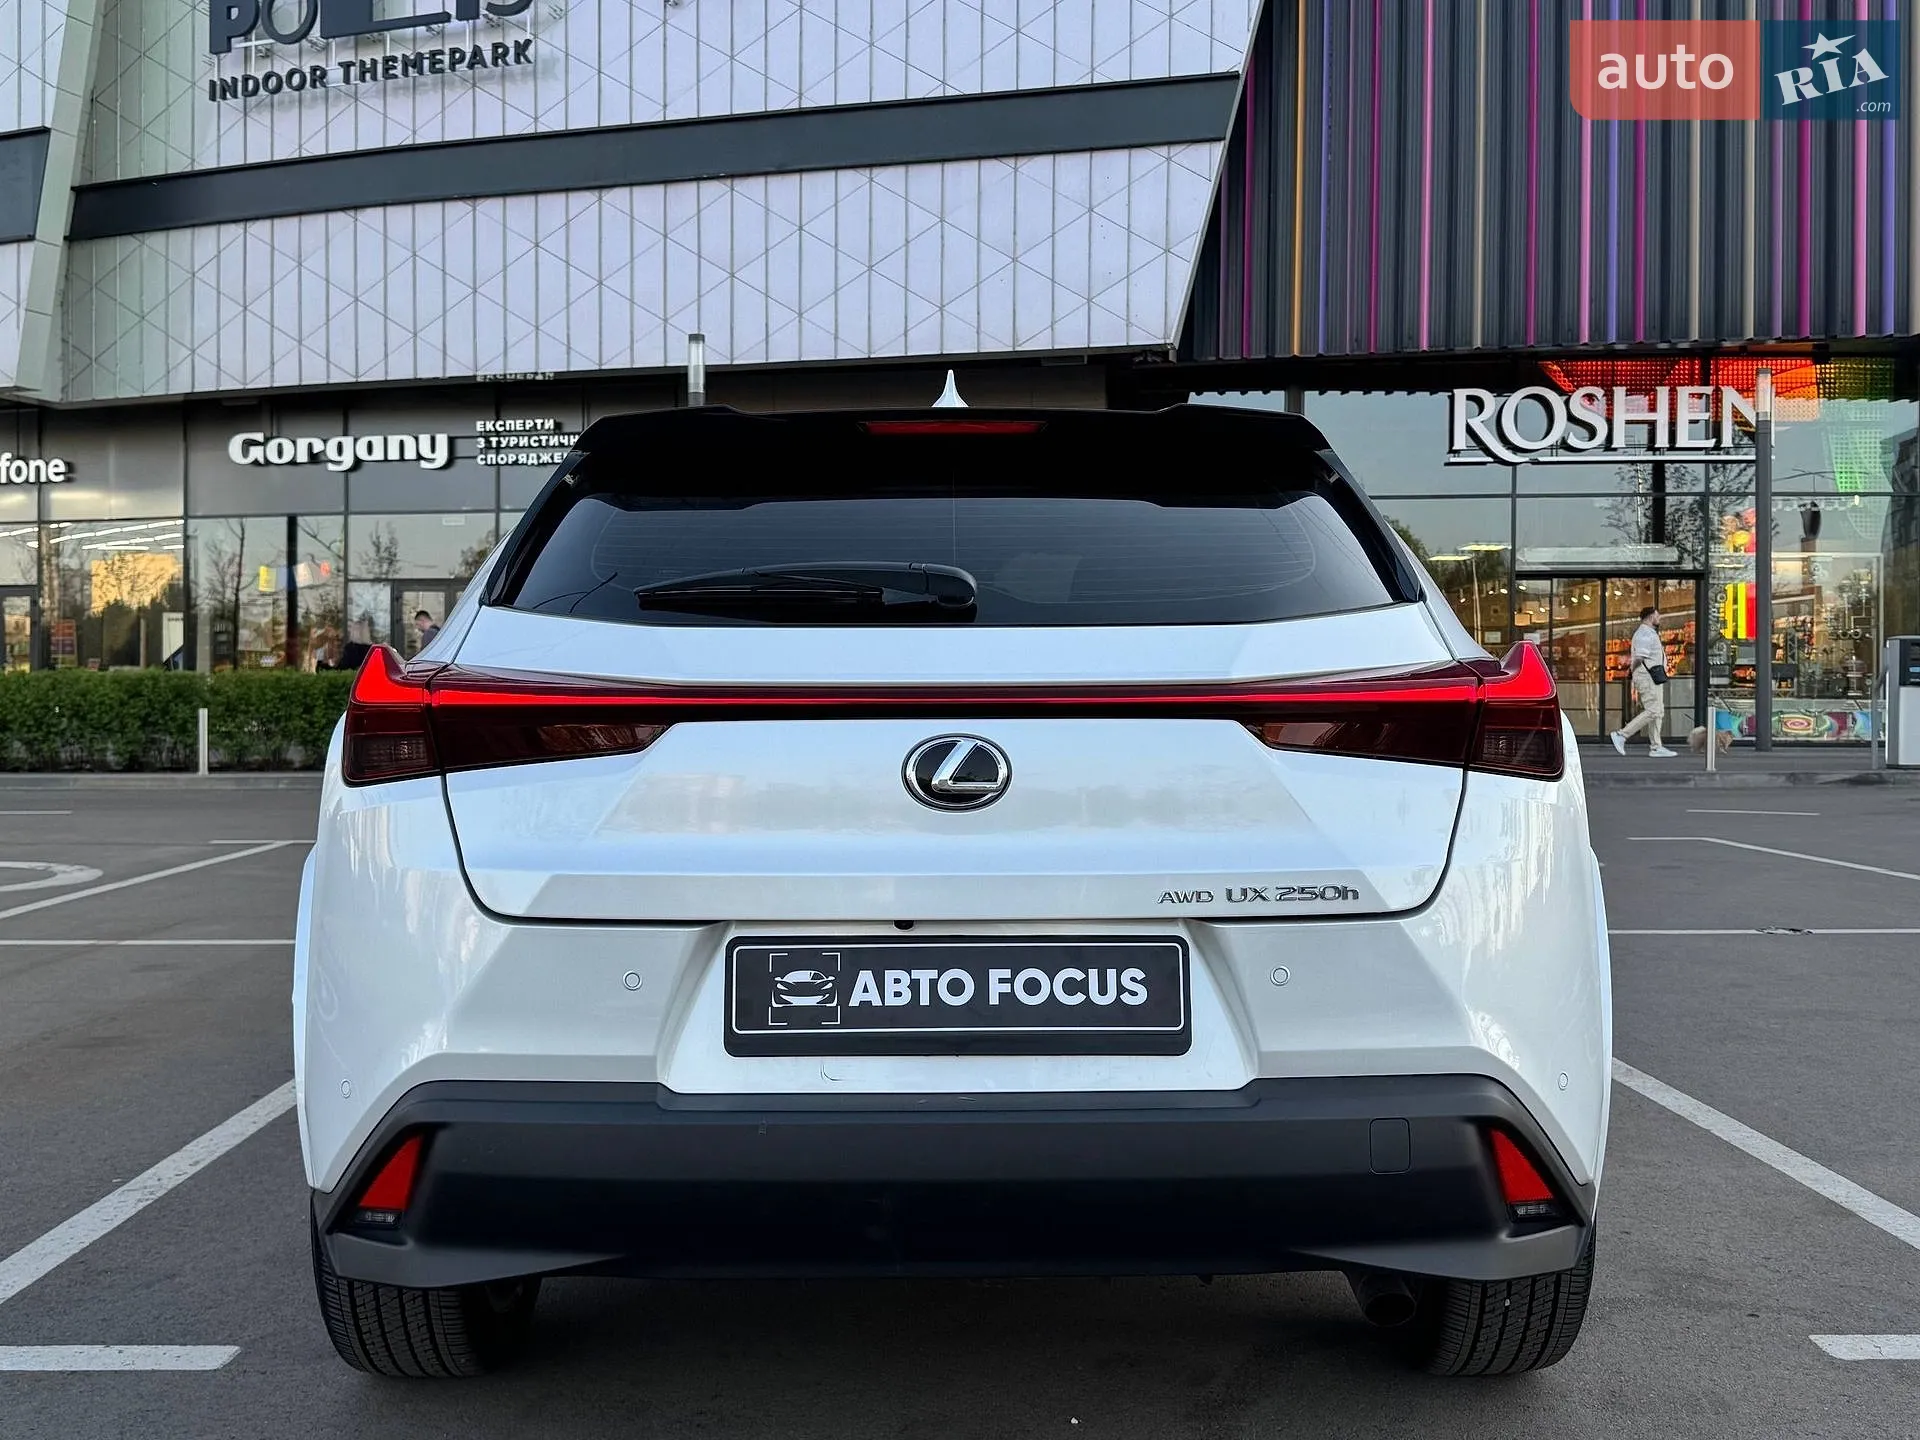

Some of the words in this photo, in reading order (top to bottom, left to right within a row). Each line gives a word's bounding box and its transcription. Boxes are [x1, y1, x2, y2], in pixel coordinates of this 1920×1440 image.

[208, 65, 327, 102] INDOOR
[338, 38, 533, 85] THEMEPARK
[476, 418, 554, 432] ЕКСПЕРТИ
[1451, 385, 1776, 463] ROSHEN
[0, 452, 66, 484] fone
[228, 431, 449, 472] Gorgany
[476, 451, 568, 466] СПОРЯДЖЕ
[1157, 888, 1214, 904] AWD
[1225, 886, 1271, 903] UX
[1275, 882, 1360, 901] 250h
[988, 967, 1148, 1006] FOCUS
